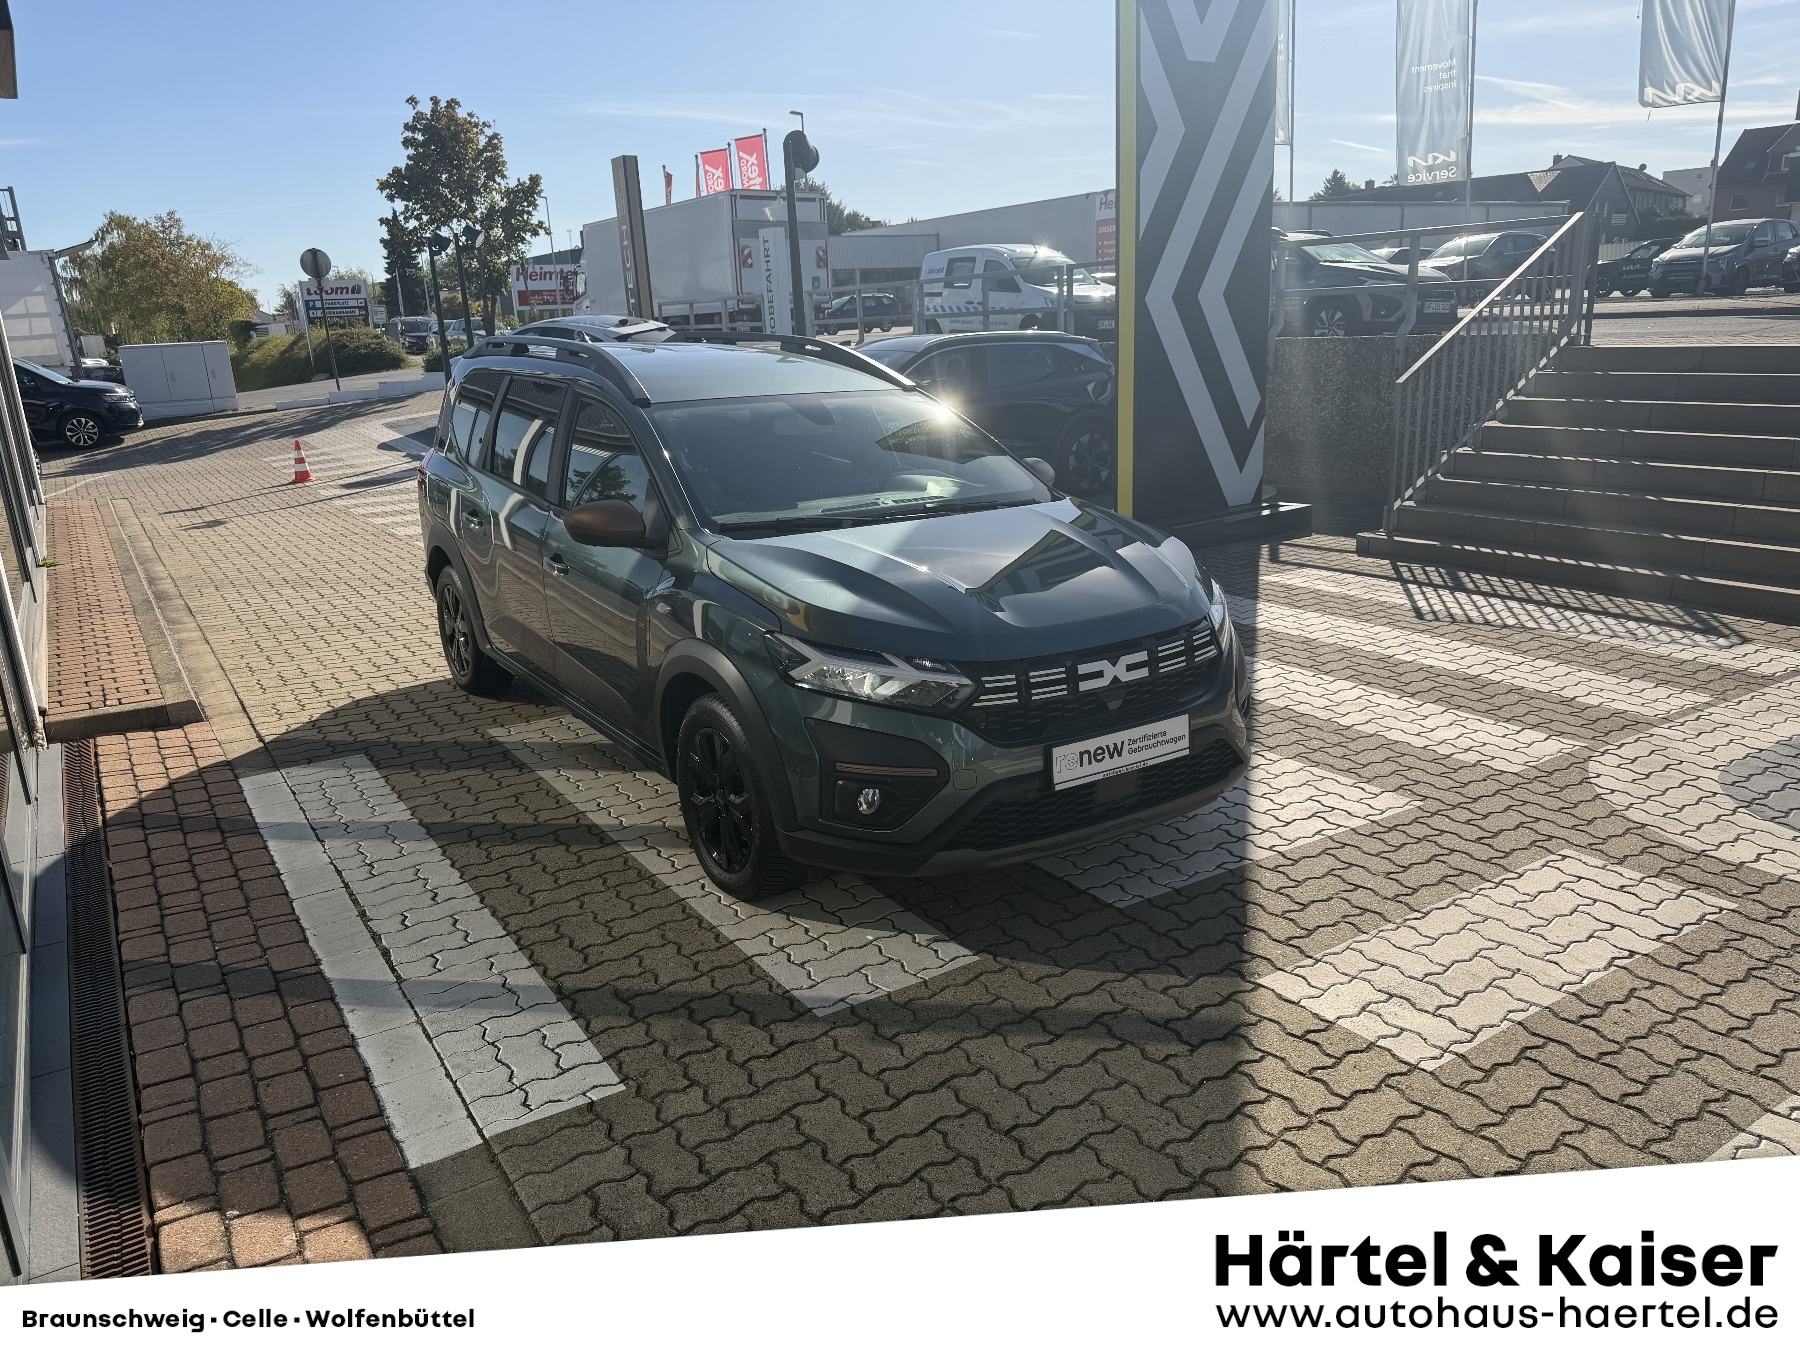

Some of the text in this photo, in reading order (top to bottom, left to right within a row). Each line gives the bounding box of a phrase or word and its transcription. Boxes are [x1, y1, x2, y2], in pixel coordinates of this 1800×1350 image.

[763, 236, 776, 334] OBEFAHRT
[1127, 730, 1167, 746] Zertifizierte
[1127, 733, 1186, 755] Gebrauchtwagen
[1055, 741, 1125, 773] renew
